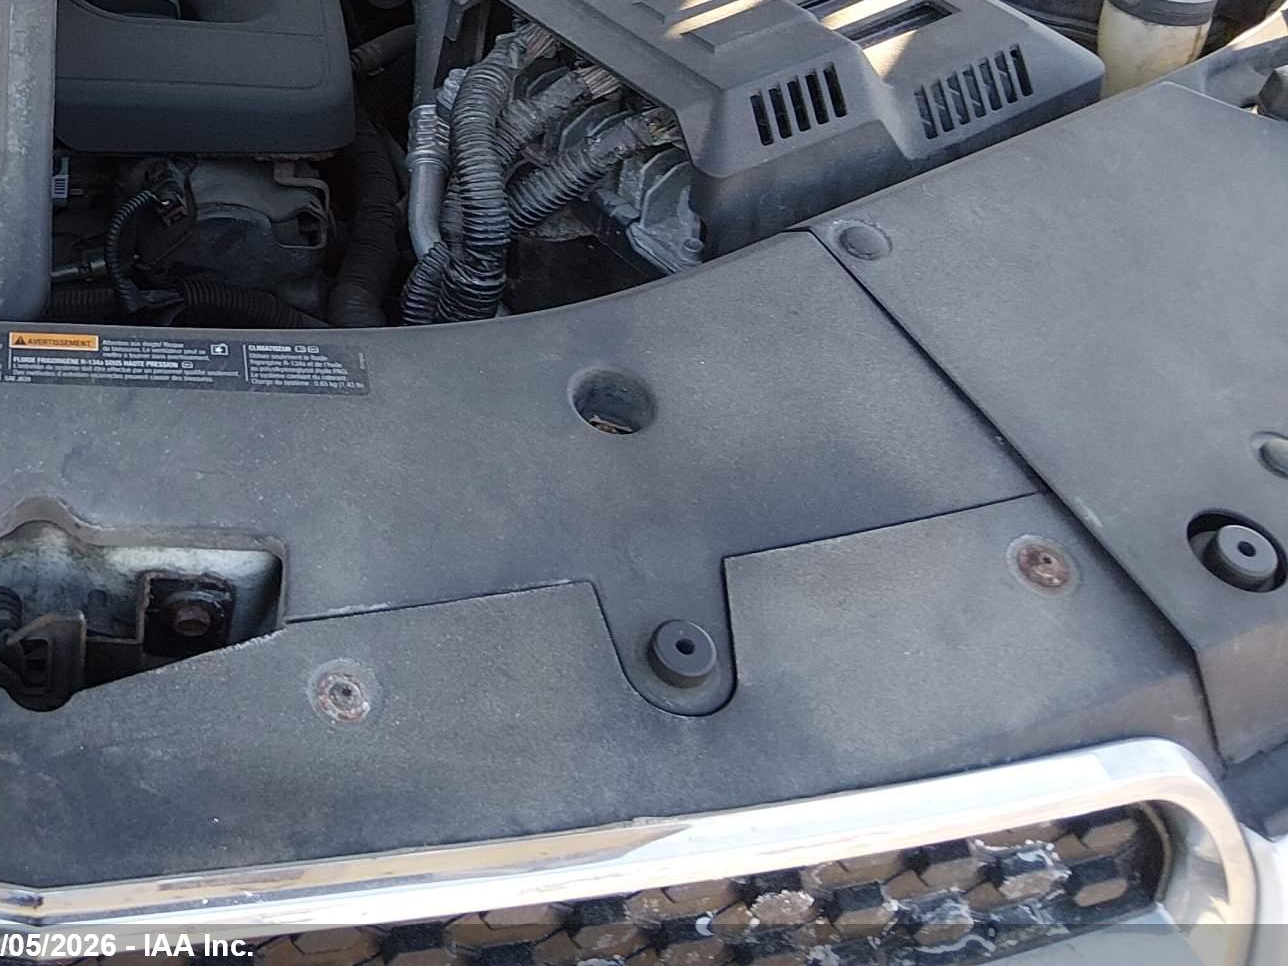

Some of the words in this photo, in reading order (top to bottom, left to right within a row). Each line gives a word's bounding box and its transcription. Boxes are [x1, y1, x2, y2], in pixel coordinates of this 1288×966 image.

[27, 339, 91, 347] AVERTISSEMENT
[13, 356, 36, 364] FLUIDE
[105, 359, 122, 367] SOUS
[123, 360, 144, 368] HAUTE
[145, 361, 178, 369] PRESSION
